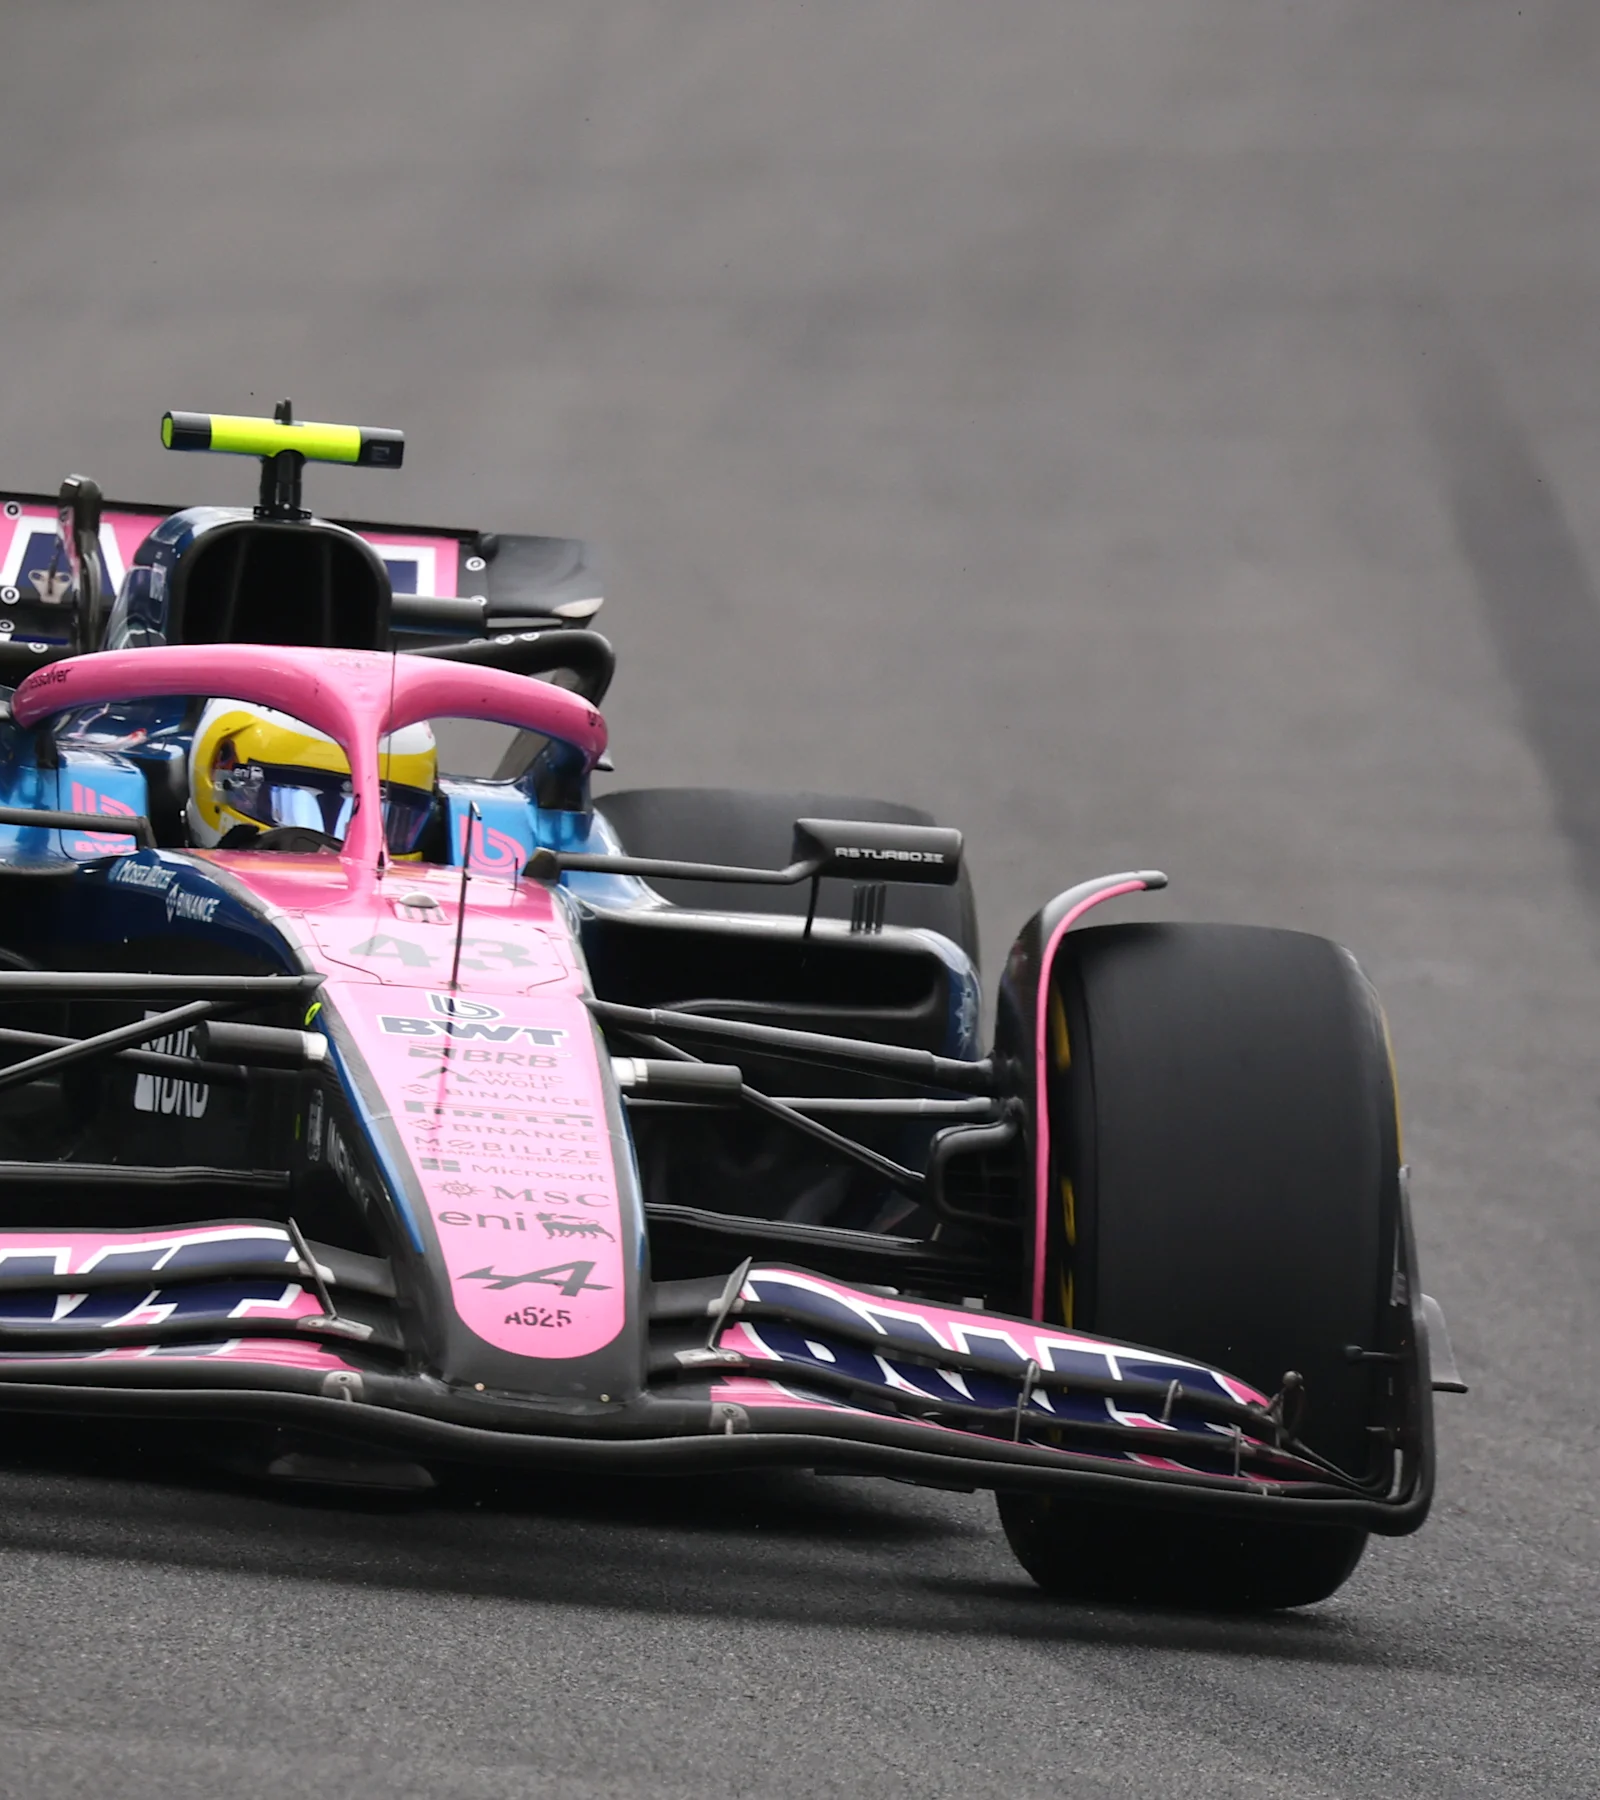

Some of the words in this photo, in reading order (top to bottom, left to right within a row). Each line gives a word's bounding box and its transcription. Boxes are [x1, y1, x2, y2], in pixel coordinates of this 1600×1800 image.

[176, 892, 220, 922] BINANCE
[350, 933, 538, 971] 43
[379, 1016, 565, 1045] BWT
[463, 1049, 558, 1068] BRB
[469, 1069, 563, 1083] ARCTIC
[484, 1078, 556, 1090] WOLF
[446, 1088, 591, 1107] BINANCE
[404, 1100, 594, 1127] PIRELLI
[453, 1124, 597, 1143] BINANCE
[417, 1147, 509, 1159] FINANCIAL
[516, 1156, 599, 1165] SERVICES
[472, 1164, 609, 1183] Microsoft
[491, 1185, 611, 1207] MSC
[438, 1211, 527, 1231] eni
[504, 1306, 572, 1328] A525
